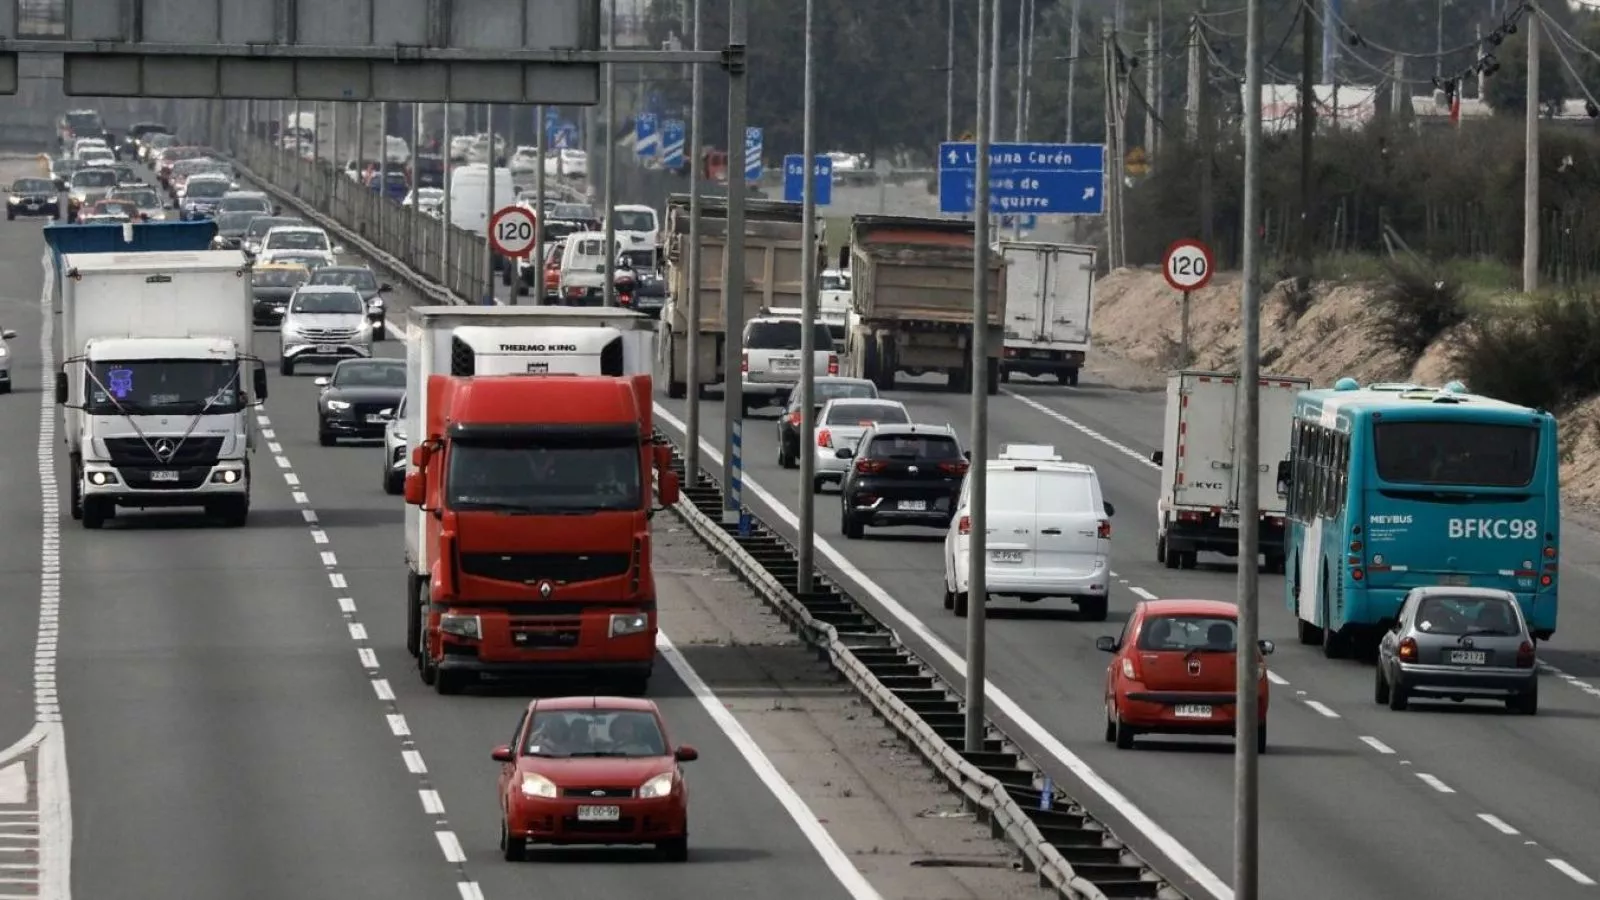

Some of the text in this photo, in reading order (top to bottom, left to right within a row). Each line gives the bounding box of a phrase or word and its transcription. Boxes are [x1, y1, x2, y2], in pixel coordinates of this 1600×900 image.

[1029, 151, 1072, 164] Carén
[1020, 178, 1039, 190] de
[498, 222, 531, 240] 120
[1172, 256, 1206, 276] 120
[1448, 518, 1537, 540] BFKC98
